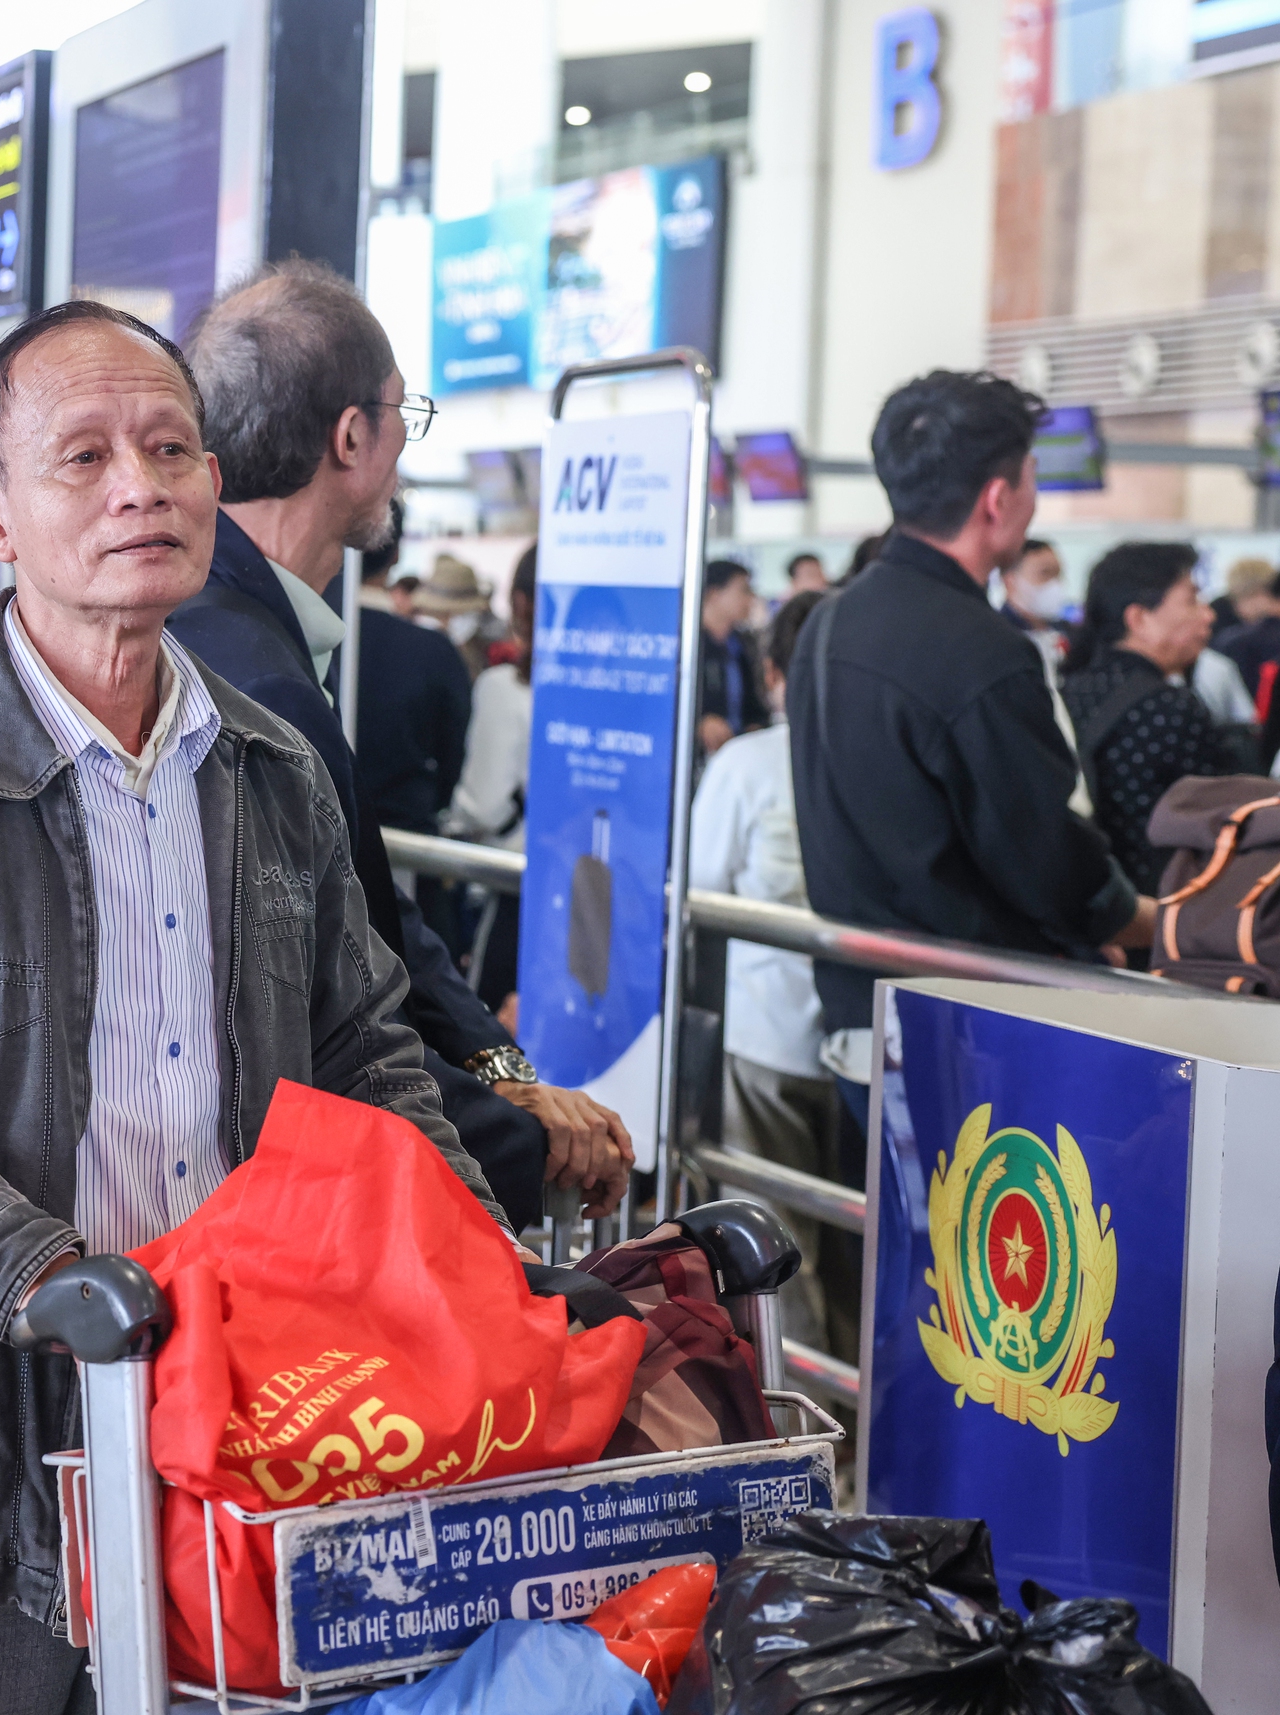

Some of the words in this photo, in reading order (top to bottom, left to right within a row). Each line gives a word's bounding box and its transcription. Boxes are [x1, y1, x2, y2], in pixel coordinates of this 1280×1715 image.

[872, 8, 941, 171] B
[554, 456, 617, 513] ACV
[224, 1348, 361, 1434] RIBANK
[293, 1385, 343, 1430] BÌNH
[442, 1522, 470, 1543] CUNG
[583, 1504, 596, 1522] XE
[620, 1494, 646, 1517] HÀNH
[648, 1492, 660, 1513] LÝ
[678, 1487, 698, 1508] CÁC
[475, 1505, 577, 1566] 20.000
[584, 1526, 610, 1549] CẢNG
[613, 1523, 639, 1545] HÀNG
[640, 1518, 672, 1540] KHÔNG
[318, 1617, 361, 1652] LIÊN
[396, 1601, 459, 1639] QUẢNG
[463, 1595, 499, 1627] CÁO
